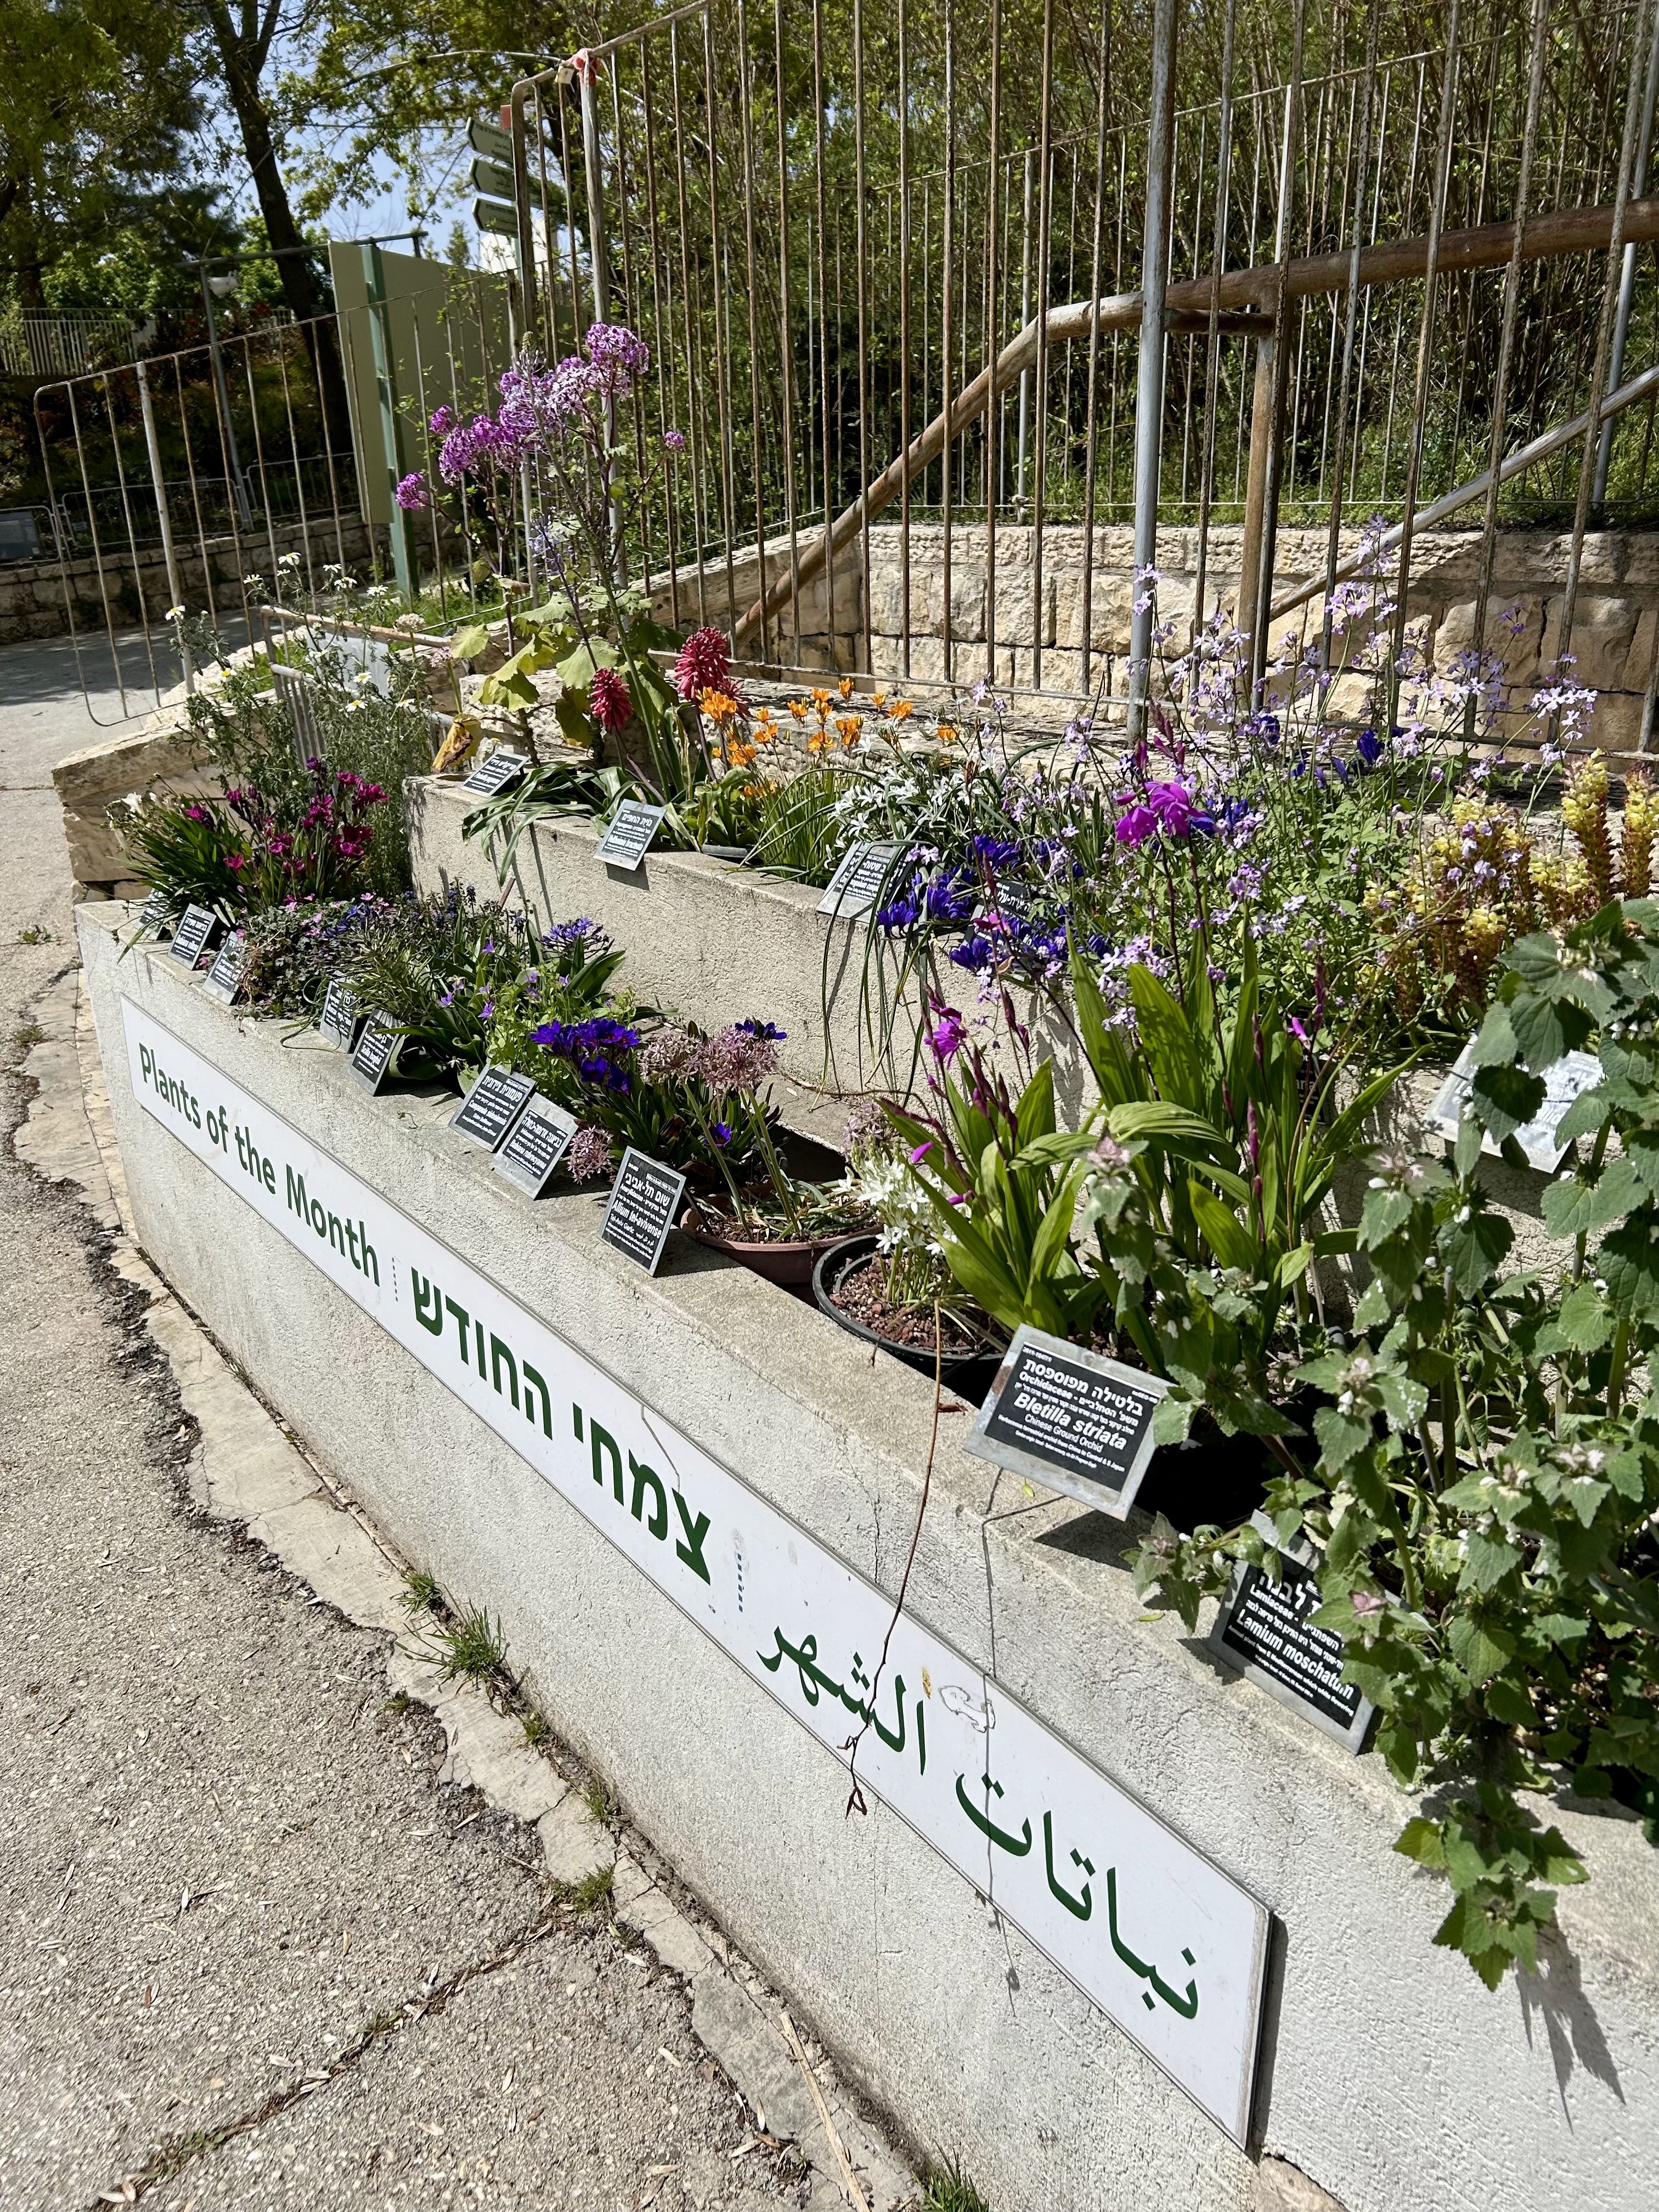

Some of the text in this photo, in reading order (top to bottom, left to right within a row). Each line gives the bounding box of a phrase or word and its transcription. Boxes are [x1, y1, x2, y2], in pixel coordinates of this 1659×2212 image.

[139, 1043, 380, 1287] Plants of the Month
[625, 1173, 654, 1198] תל-אביבי
[654, 1191, 670, 1206] שום
[611, 1198, 630, 1218] Allium
[629, 1210, 662, 1238] tel-avivense
[1019, 1372, 1073, 1400] Orchidaceae
[1023, 1359, 1143, 1416] בלטילה מפוספסת
[1014, 1392, 1127, 1450] Bletilla striata
[1079, 1397, 1116, 1418] הסחלביים
[1119, 1410, 1138, 1426] משפ'
[411, 1267, 710, 1585] צמחי החודש
[1025, 1414, 1103, 1453] Chinese Ground Orchid
[1043, 1435, 1058, 1443] orchid
[1057, 1439, 1068, 1448] from
[1068, 1444, 1081, 1454] China
[1086, 1452, 1103, 1463] Central
[1246, 1600, 1259, 1612] לבנה
[1250, 1584, 1294, 1620] Lamiaceae
[1273, 1616, 1283, 1629] בעל
[1237, 1609, 1283, 1651] Lamium
[1283, 1644, 1353, 1699] moschatum
[1256, 1644, 1267, 1655] from
[1298, 1634, 1308, 1646] הים
[757, 1626, 1198, 2019] نباتات الشهر
